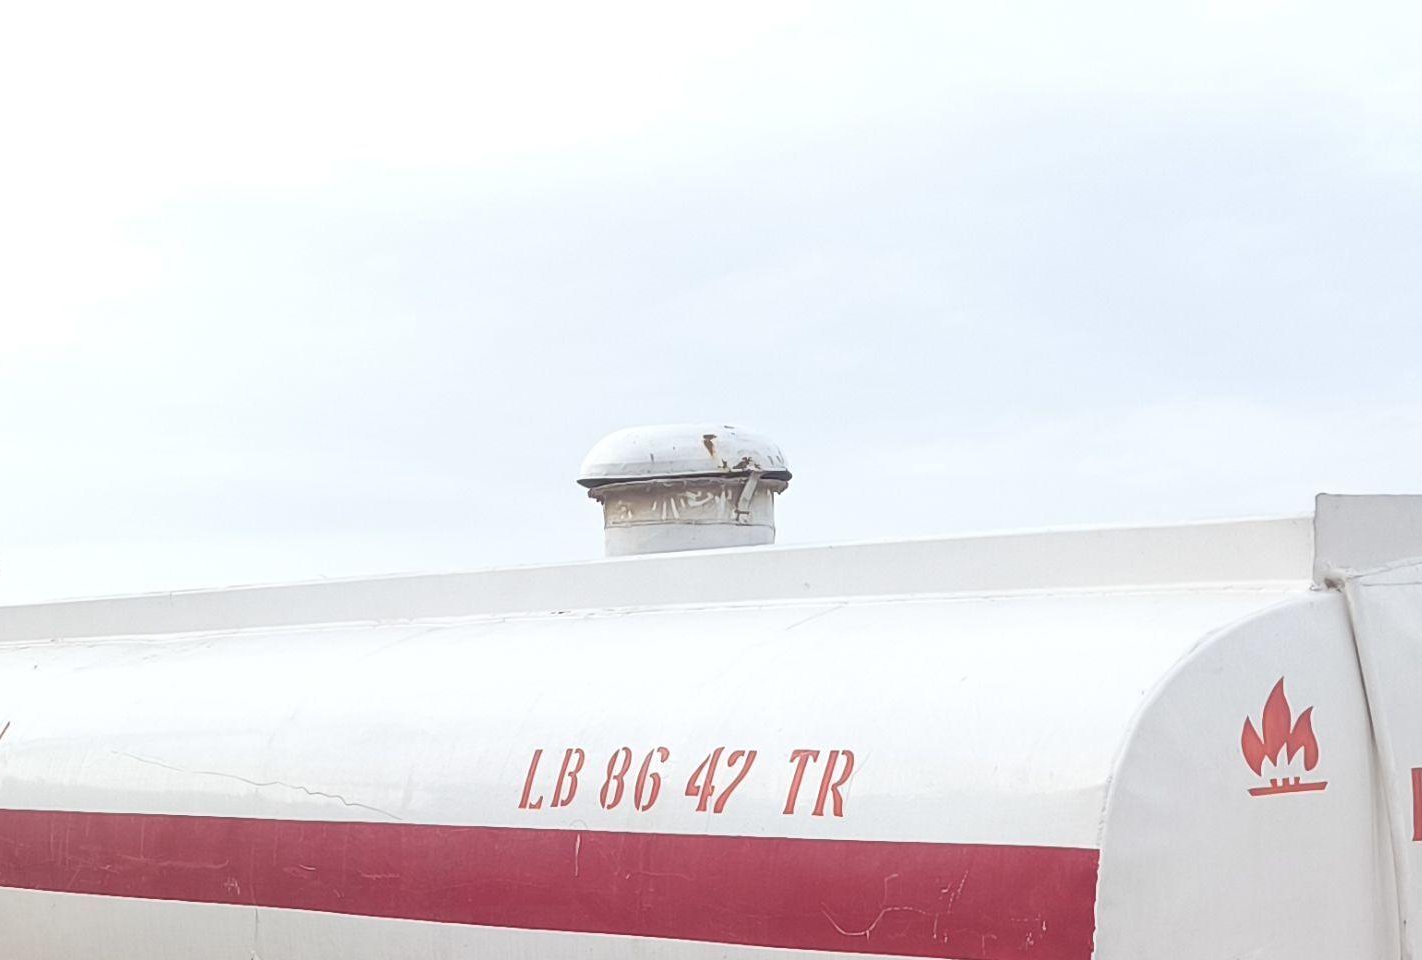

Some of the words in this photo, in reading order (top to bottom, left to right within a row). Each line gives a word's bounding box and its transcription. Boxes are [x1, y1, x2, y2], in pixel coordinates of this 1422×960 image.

[518, 748, 587, 811] LB
[599, 746, 670, 814] 86
[684, 746, 758, 815] 47
[782, 748, 856, 818] TR
